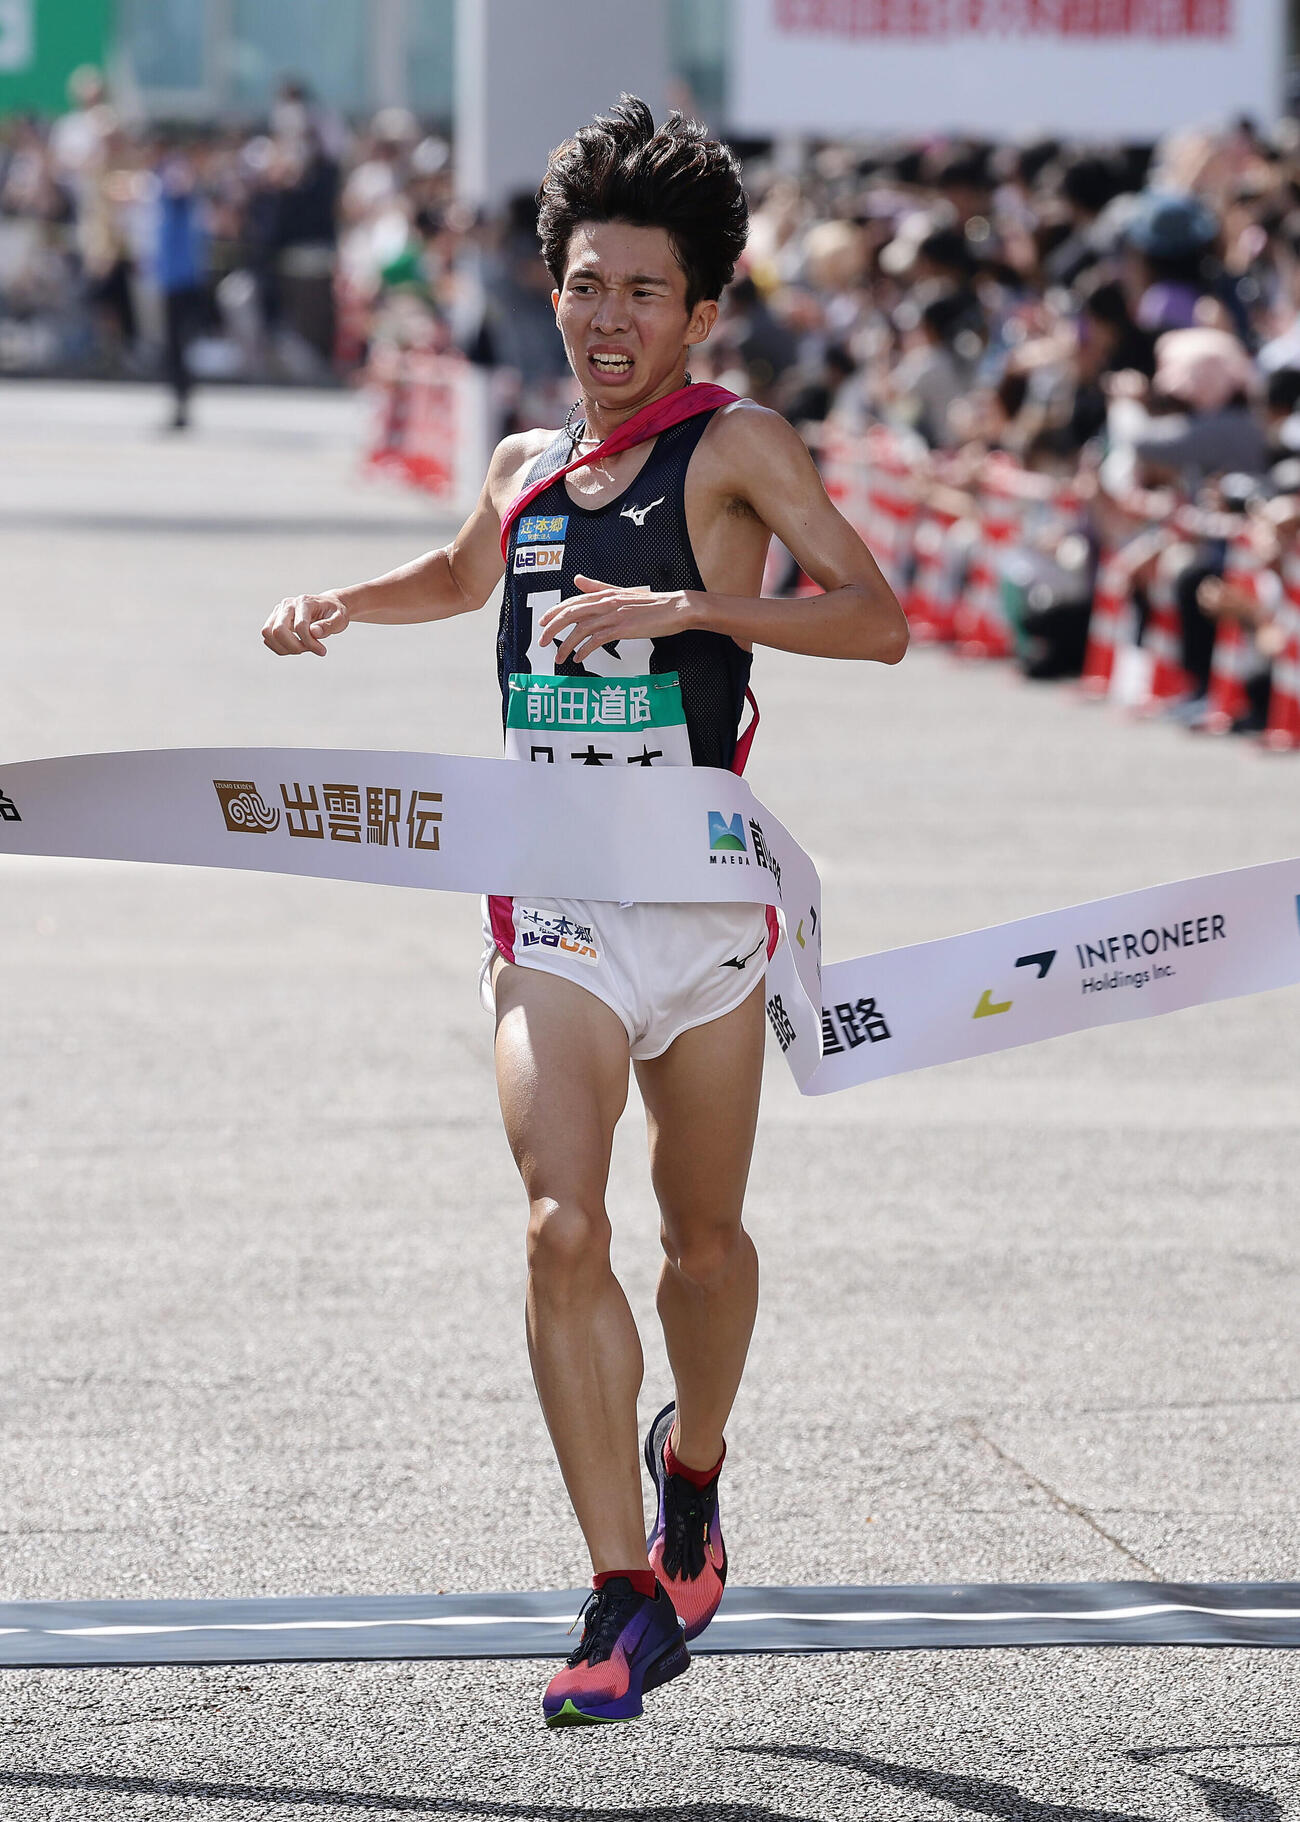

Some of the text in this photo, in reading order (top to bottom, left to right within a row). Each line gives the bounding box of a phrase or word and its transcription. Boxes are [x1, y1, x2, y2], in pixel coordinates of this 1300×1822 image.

[527, 683, 652, 725] 前田道路
[279, 782, 443, 851] 出雲駅伝
[709, 855, 750, 866] MAEDA
[1076, 914, 1227, 969] INFRONEER
[1081, 963, 1176, 994] Holdings Inc.
